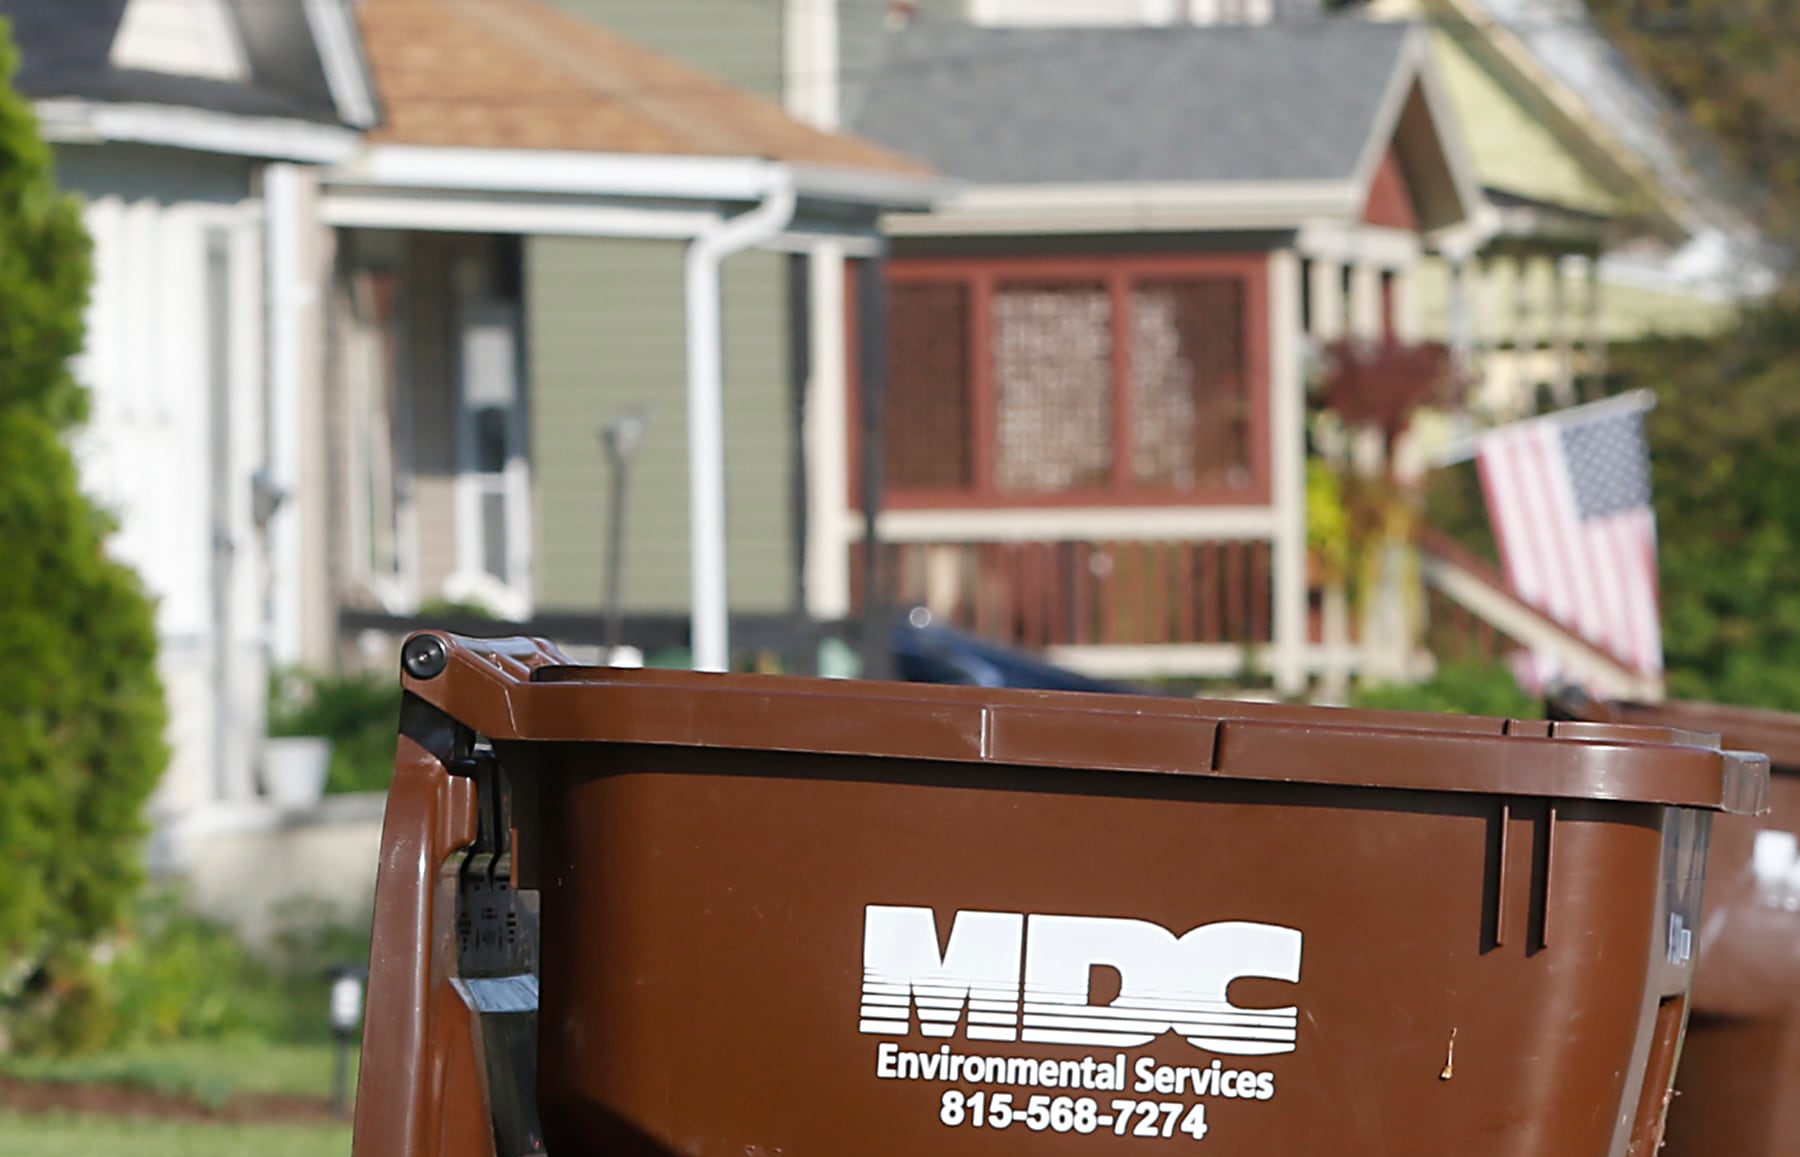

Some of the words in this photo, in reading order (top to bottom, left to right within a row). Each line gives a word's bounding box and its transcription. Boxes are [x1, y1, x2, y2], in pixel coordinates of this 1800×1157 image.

[859, 905, 1303, 1056] MDC
[877, 1043, 1126, 1091] Environmental
[1134, 1058, 1274, 1100] Services
[940, 1090, 1208, 1140] 815-568-7274
